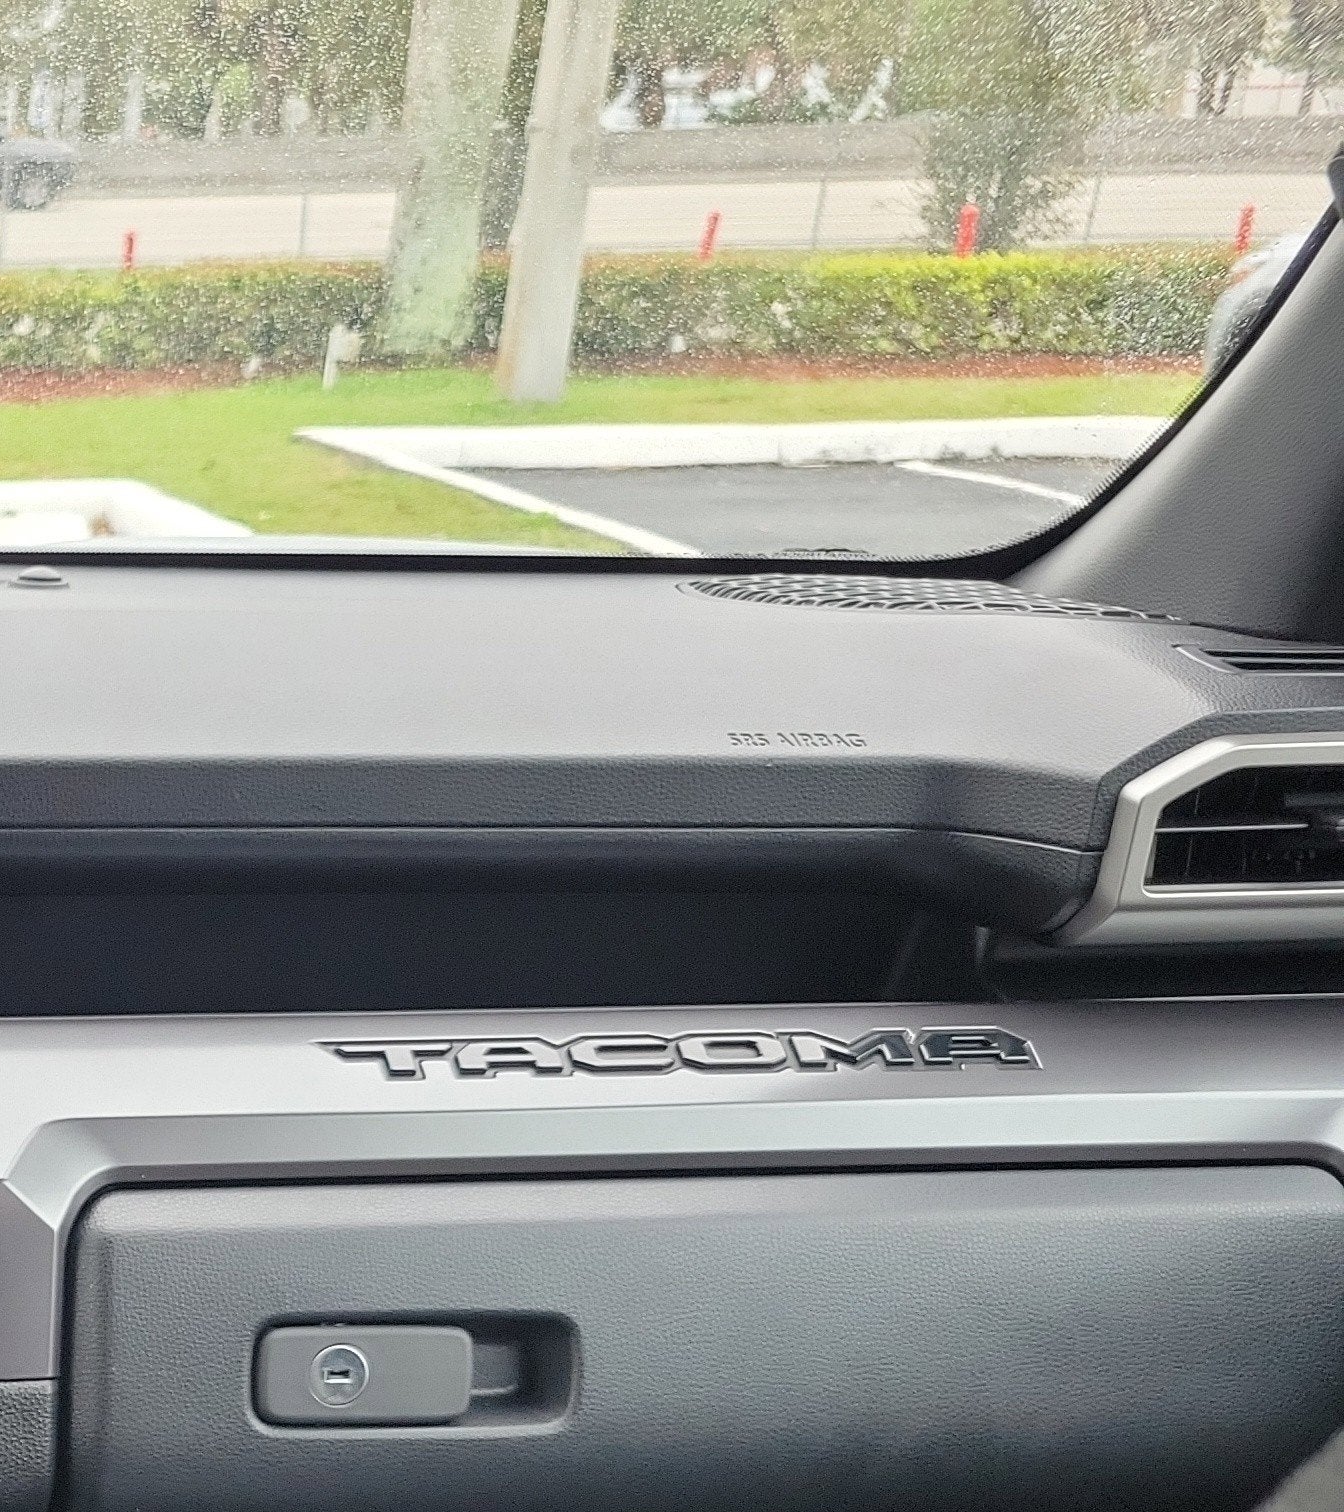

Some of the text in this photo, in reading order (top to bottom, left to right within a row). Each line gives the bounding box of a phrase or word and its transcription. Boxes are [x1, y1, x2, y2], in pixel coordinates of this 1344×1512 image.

[727, 732, 868, 747] SRS AIRBAG
[324, 1026, 1042, 1080] TACOMA
